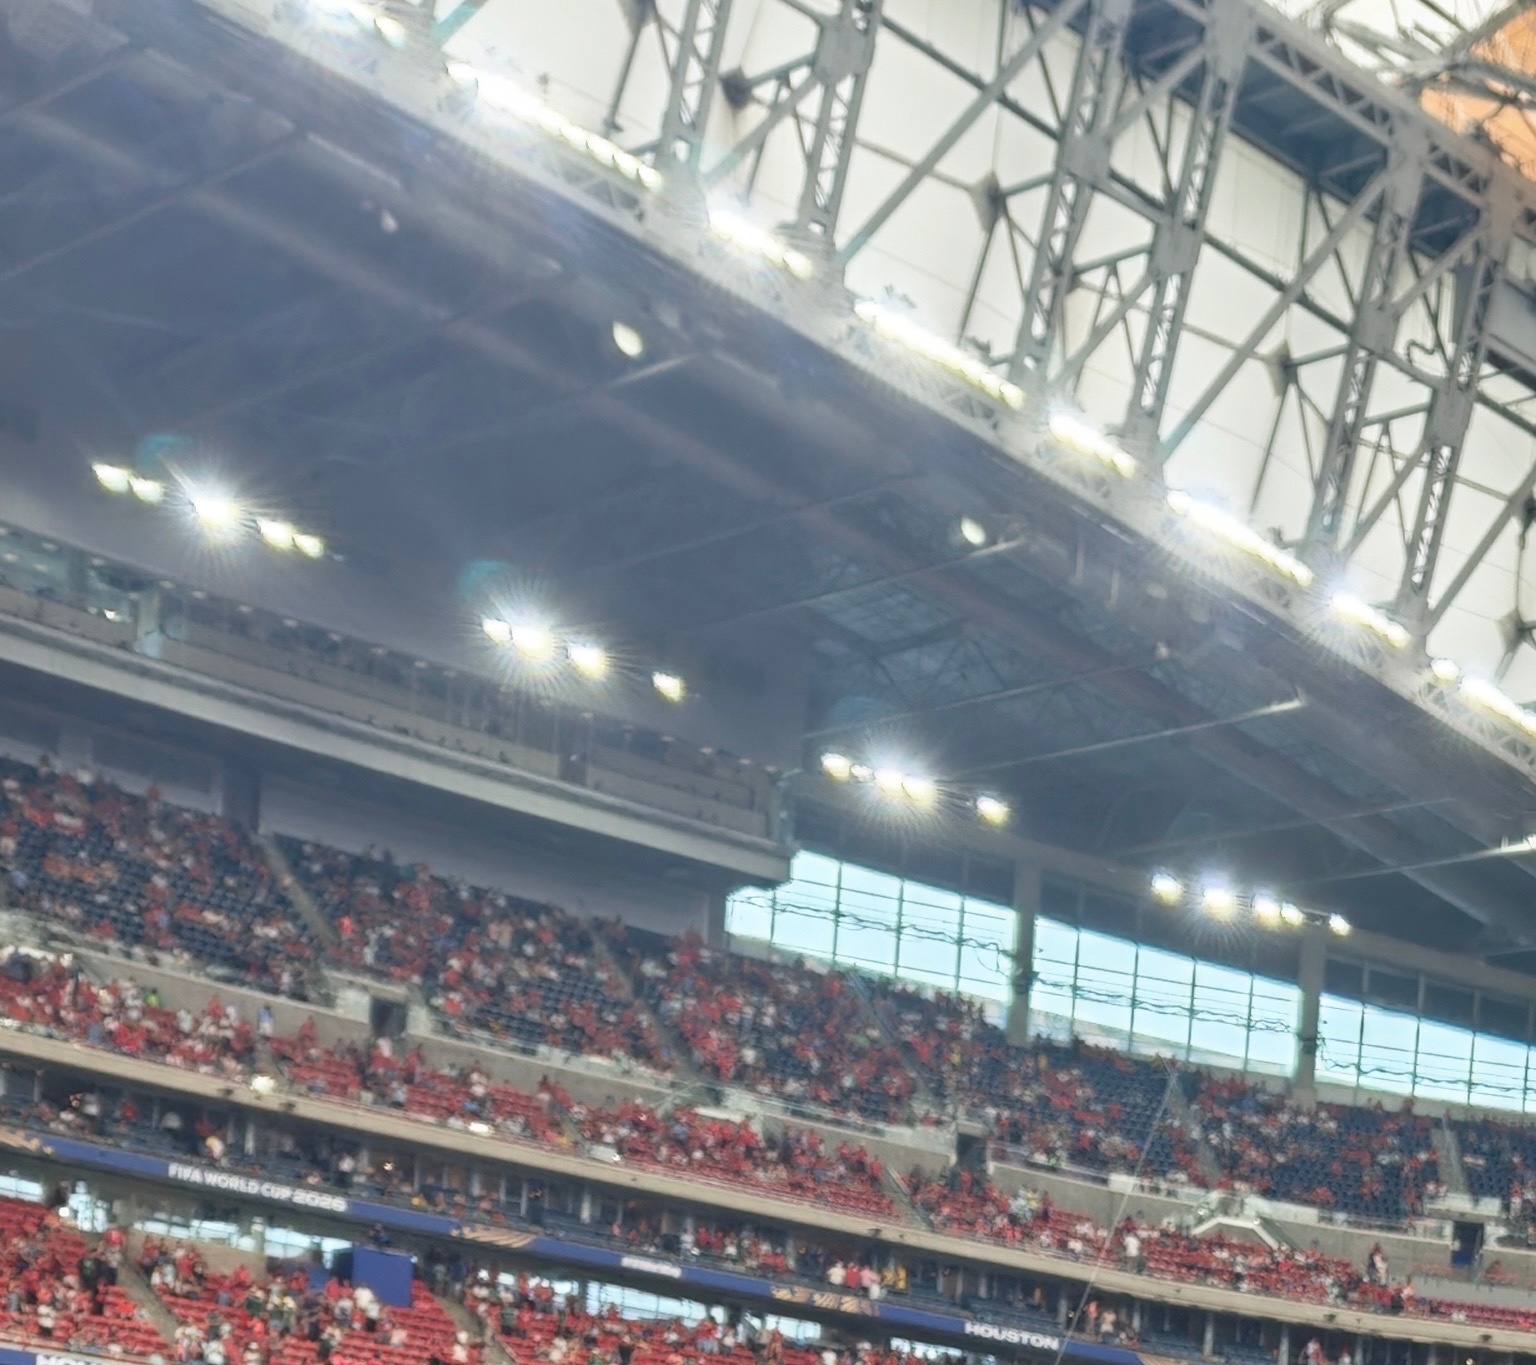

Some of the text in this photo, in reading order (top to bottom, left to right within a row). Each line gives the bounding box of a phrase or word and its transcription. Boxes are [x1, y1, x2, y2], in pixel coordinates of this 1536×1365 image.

[168, 1162, 348, 1213] FIFA WORLD CUP 2026
[964, 1320, 1060, 1351] HOUSTON
